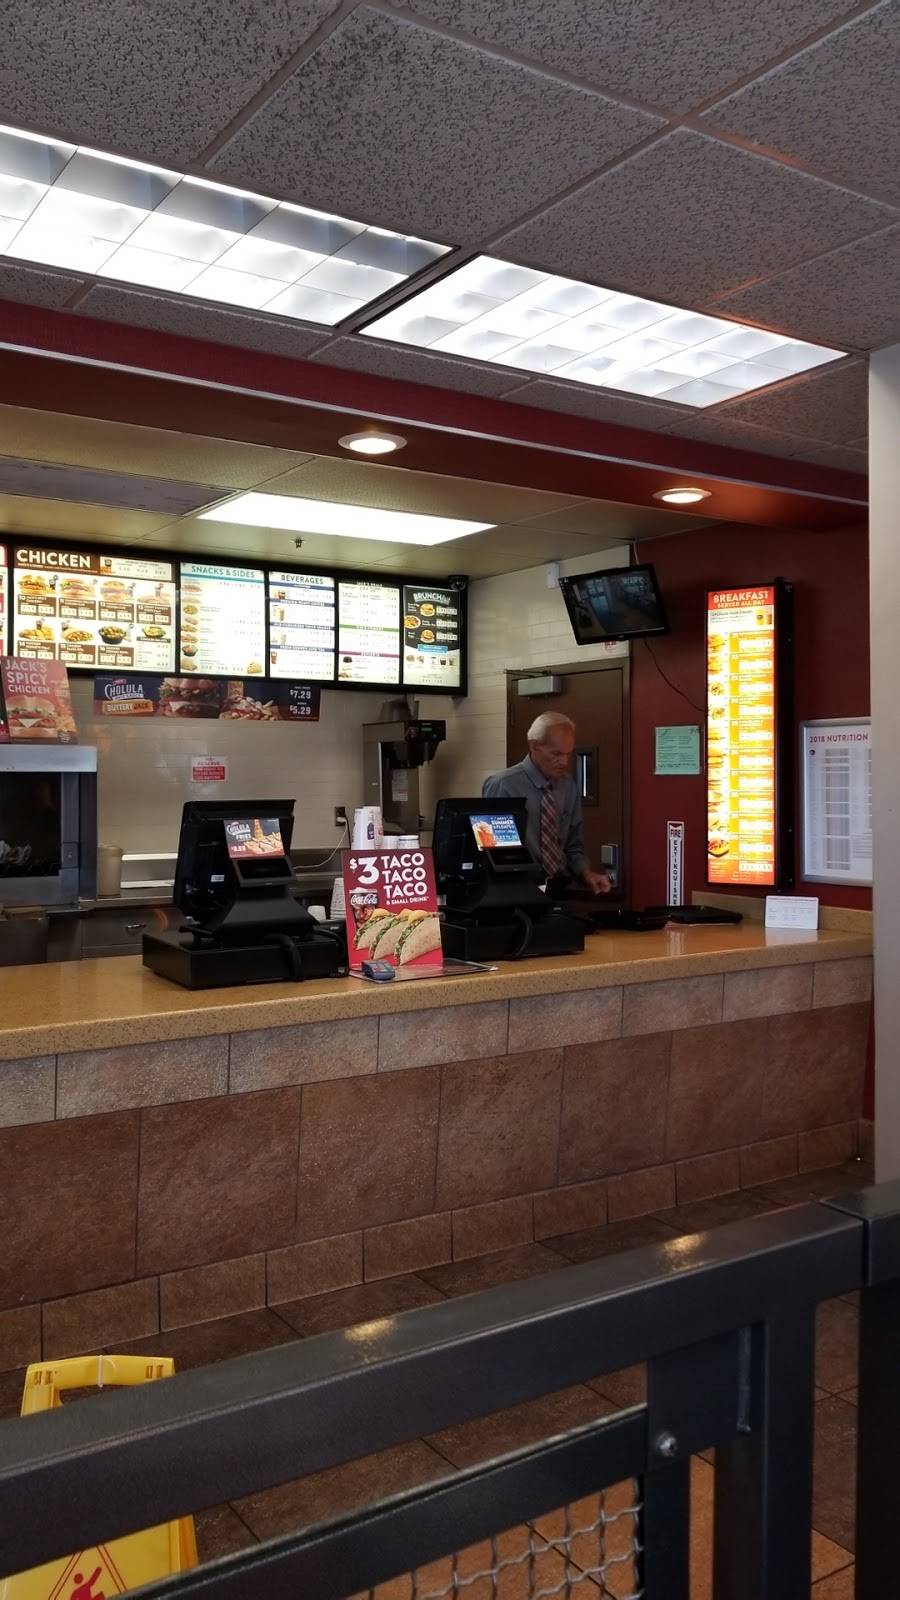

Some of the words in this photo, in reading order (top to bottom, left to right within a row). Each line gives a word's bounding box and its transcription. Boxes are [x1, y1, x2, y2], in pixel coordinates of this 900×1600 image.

[16, 549, 91, 569] CHICKEN
[191, 565, 223, 576] SNACKS
[232, 570, 255, 579] SIDES
[281, 574, 324, 585] BEVERAGES
[713, 591, 769, 603] BREAKFAST
[5, 659, 48, 673] JACK'S
[7, 671, 48, 685] SPICY
[8, 684, 50, 694] CHICKEN
[104, 683, 144, 700] CHOLULA
[289, 689, 311, 699] $7.29
[107, 702, 132, 712] BUTTERY
[289, 705, 311, 715] $5.29
[809, 735, 826, 744] 2018
[827, 734, 869, 743] NUTRITION
[670, 828, 681, 838] FIRE
[380, 852, 425, 870] TACO
[349, 856, 380, 885] $3
[381, 866, 427, 885] TACO
[383, 881, 428, 900] TACO
